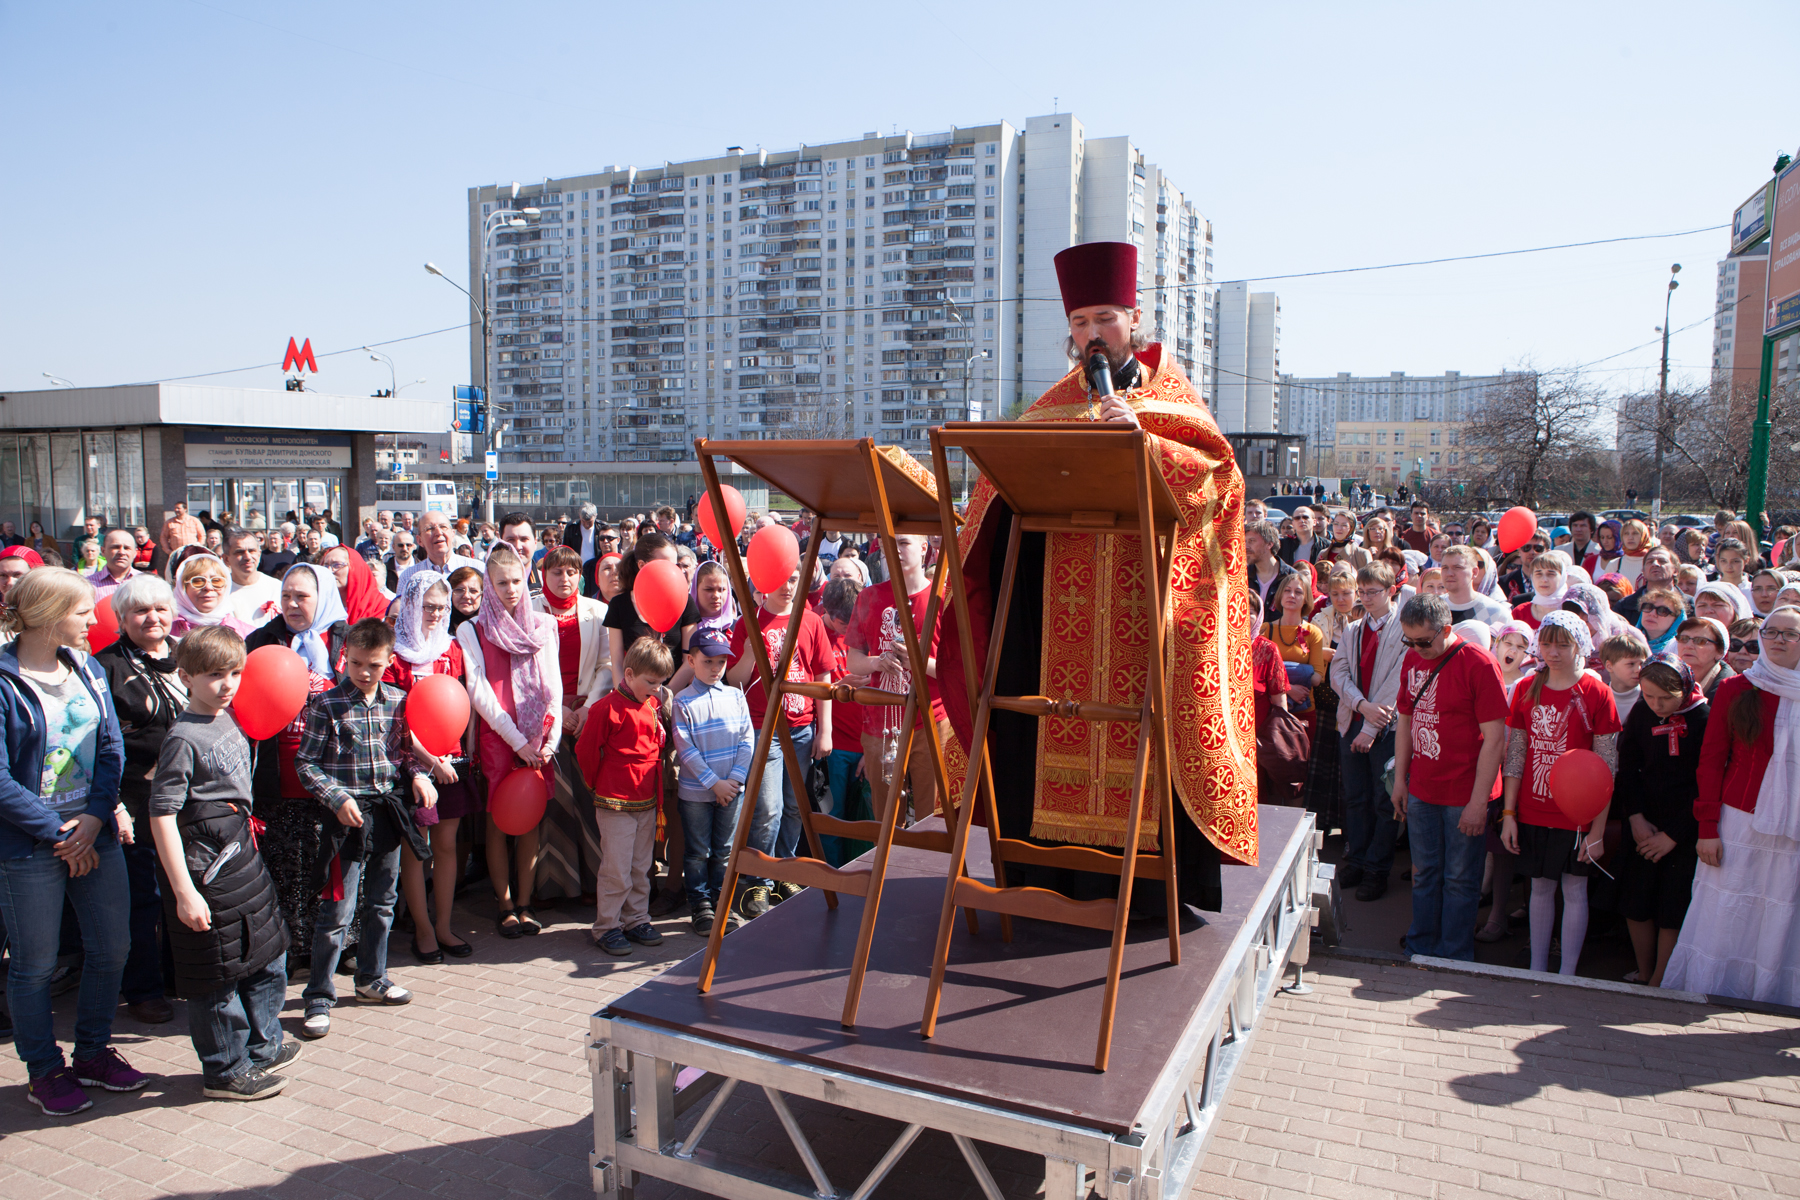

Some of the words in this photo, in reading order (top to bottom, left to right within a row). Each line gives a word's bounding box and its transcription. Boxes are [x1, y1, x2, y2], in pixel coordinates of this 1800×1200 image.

[1784, 182, 1800, 204] СОГЛ
[281, 336, 319, 373] М
[224, 436, 269, 444] МОСКОВСКИЙ
[272, 437, 319, 445] МЕТРОПОЛИТЕН
[266, 449, 298, 457] ДМИТРИЯ
[1530, 735, 1557, 754] Христос
[40, 786, 87, 805] OLLEGE
